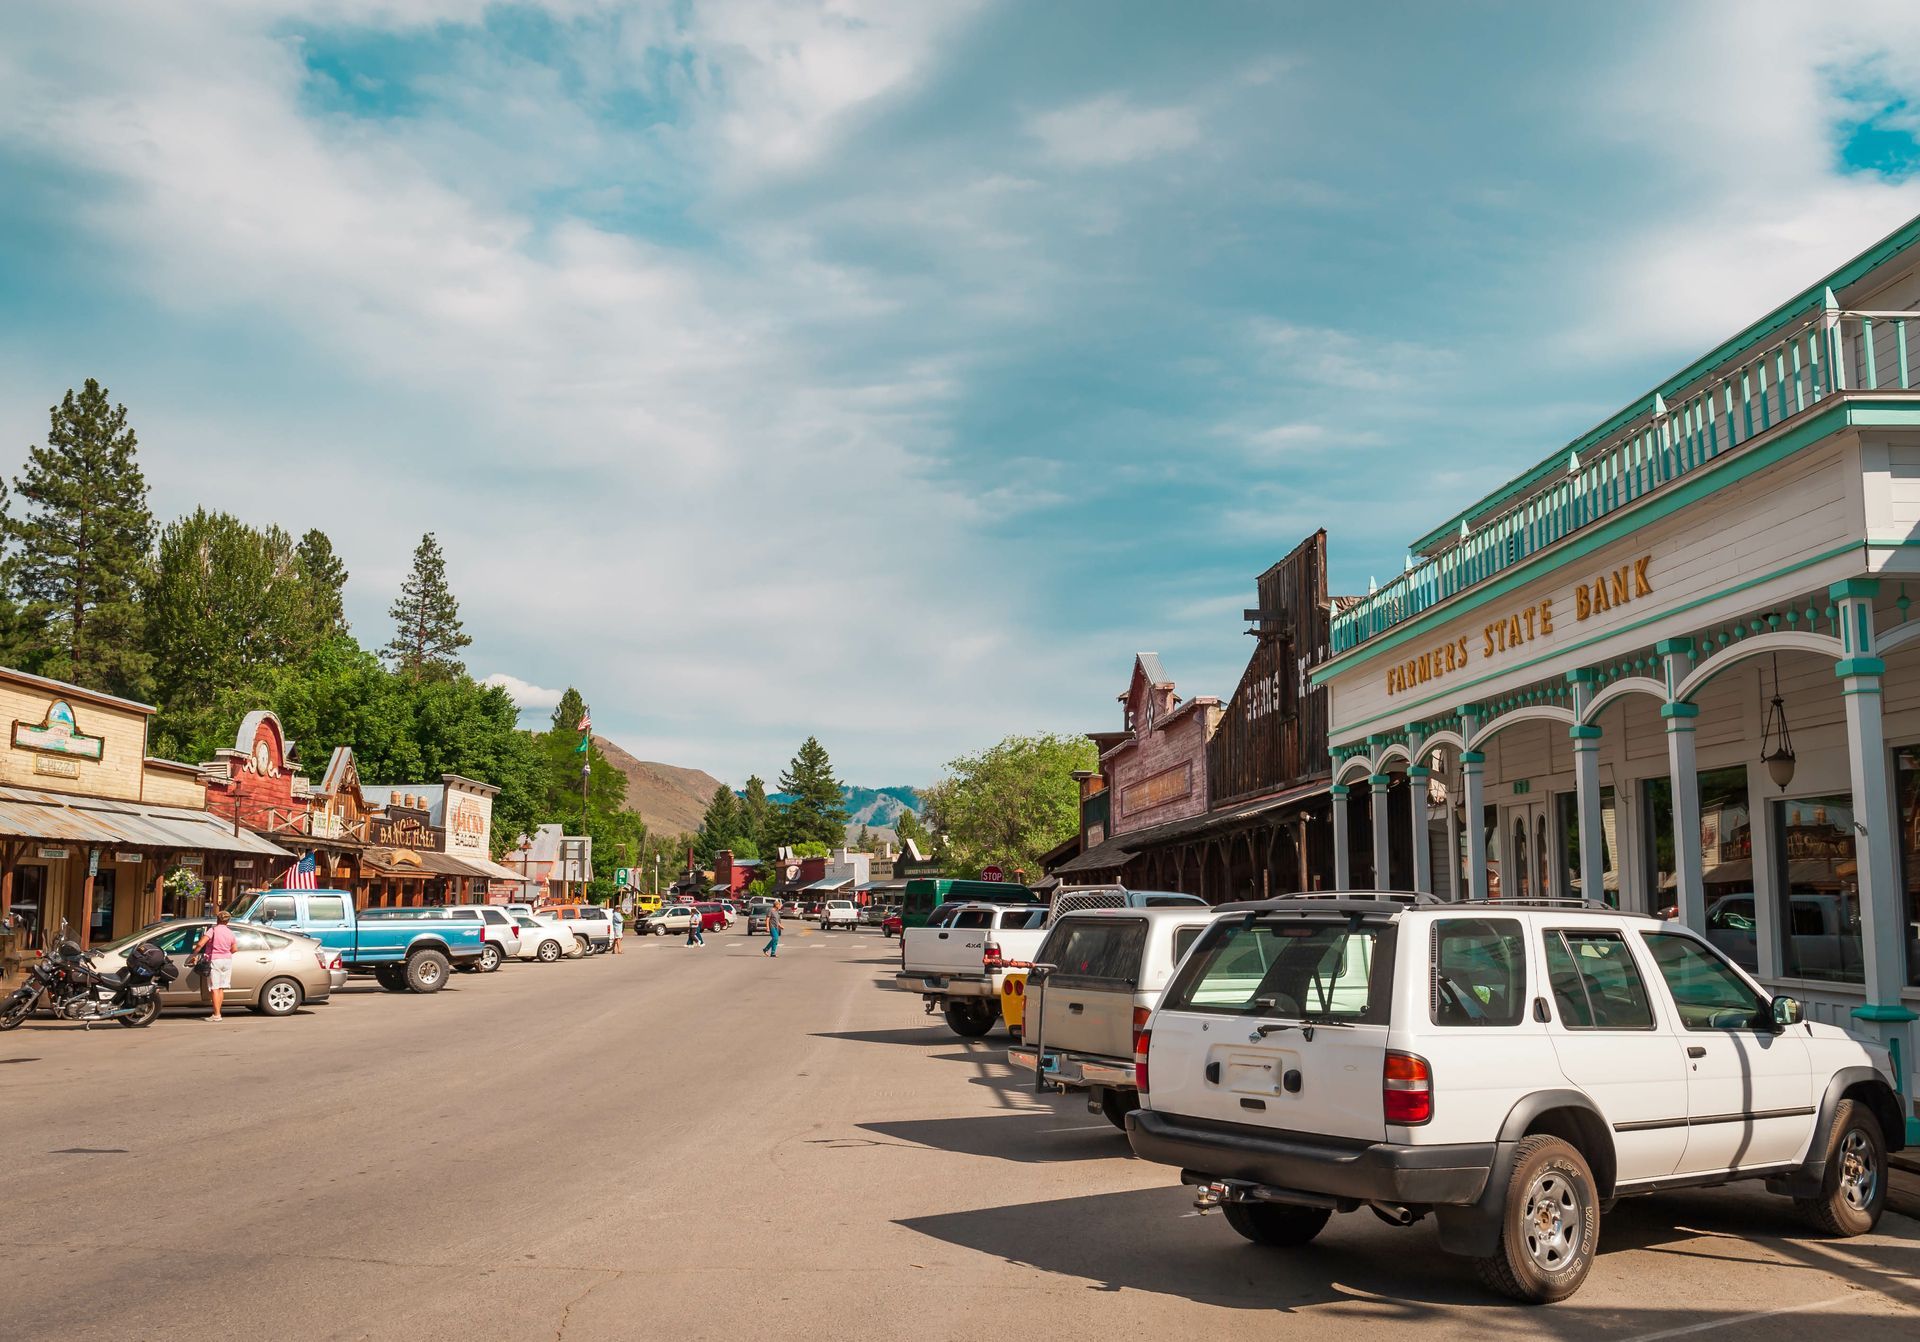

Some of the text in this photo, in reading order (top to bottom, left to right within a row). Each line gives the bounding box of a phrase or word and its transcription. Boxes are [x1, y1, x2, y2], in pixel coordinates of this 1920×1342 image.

[1386, 635, 1468, 696] FARMERS
[1483, 599, 1554, 658] STATE
[1575, 555, 1654, 622] BANK
[380, 818, 436, 848] DANCE HALL
[455, 832, 480, 848] SALOON
[983, 872, 1002, 881] STOP
[1581, 1206, 1595, 1255] WILD
